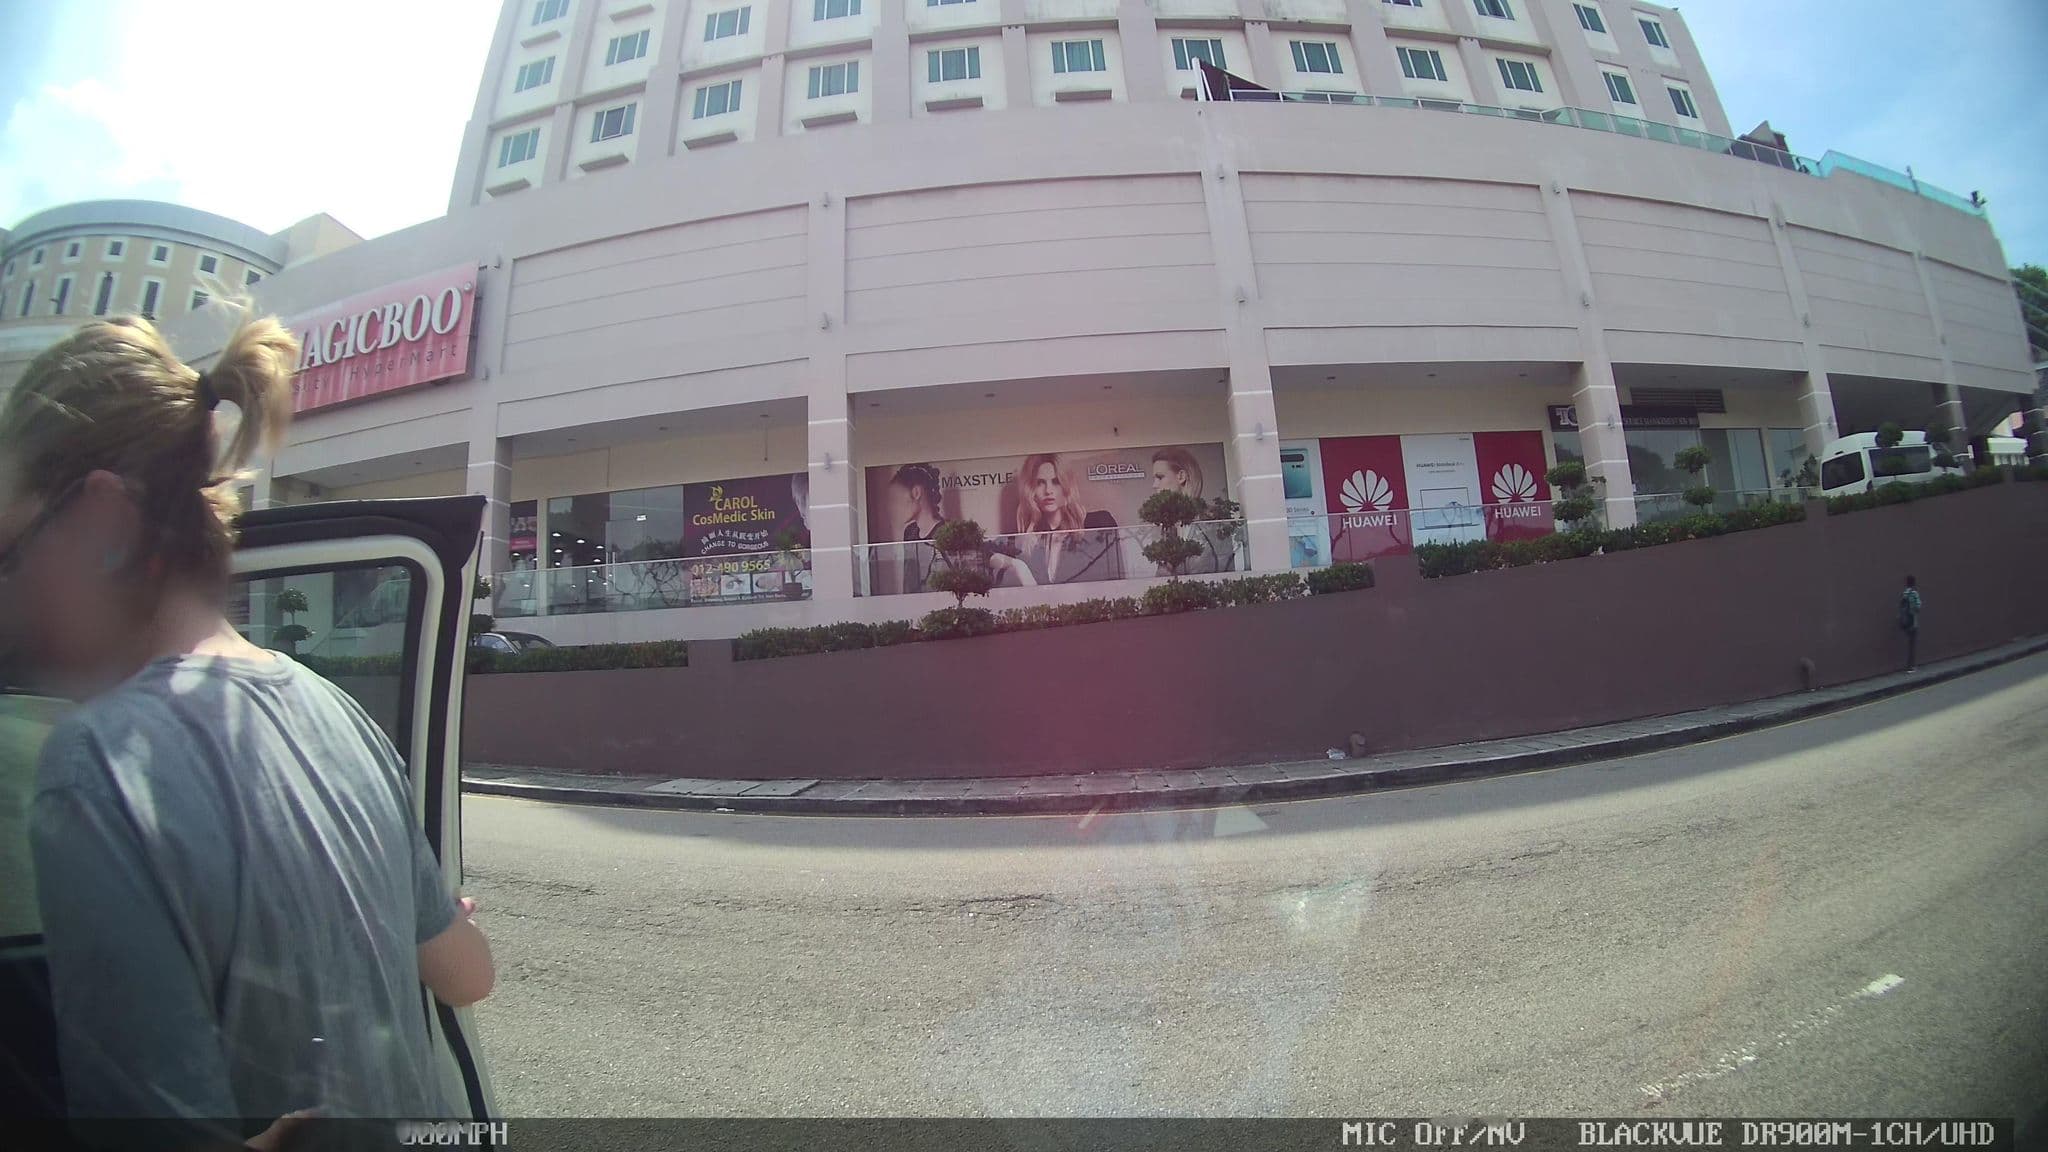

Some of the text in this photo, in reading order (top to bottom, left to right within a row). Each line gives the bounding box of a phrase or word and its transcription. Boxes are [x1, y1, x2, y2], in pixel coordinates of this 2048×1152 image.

[941, 472, 1014, 488] MAXSTYLE
[714, 495, 758, 511] CAROL
[692, 507, 776, 526] CosMedic Skin
[1494, 505, 1541, 519] HUAWEI
[1342, 513, 1397, 529] HUAWEI
[700, 540, 726, 555] CHANGE
[727, 540, 737, 548] TO
[741, 558, 771, 572] 9565
